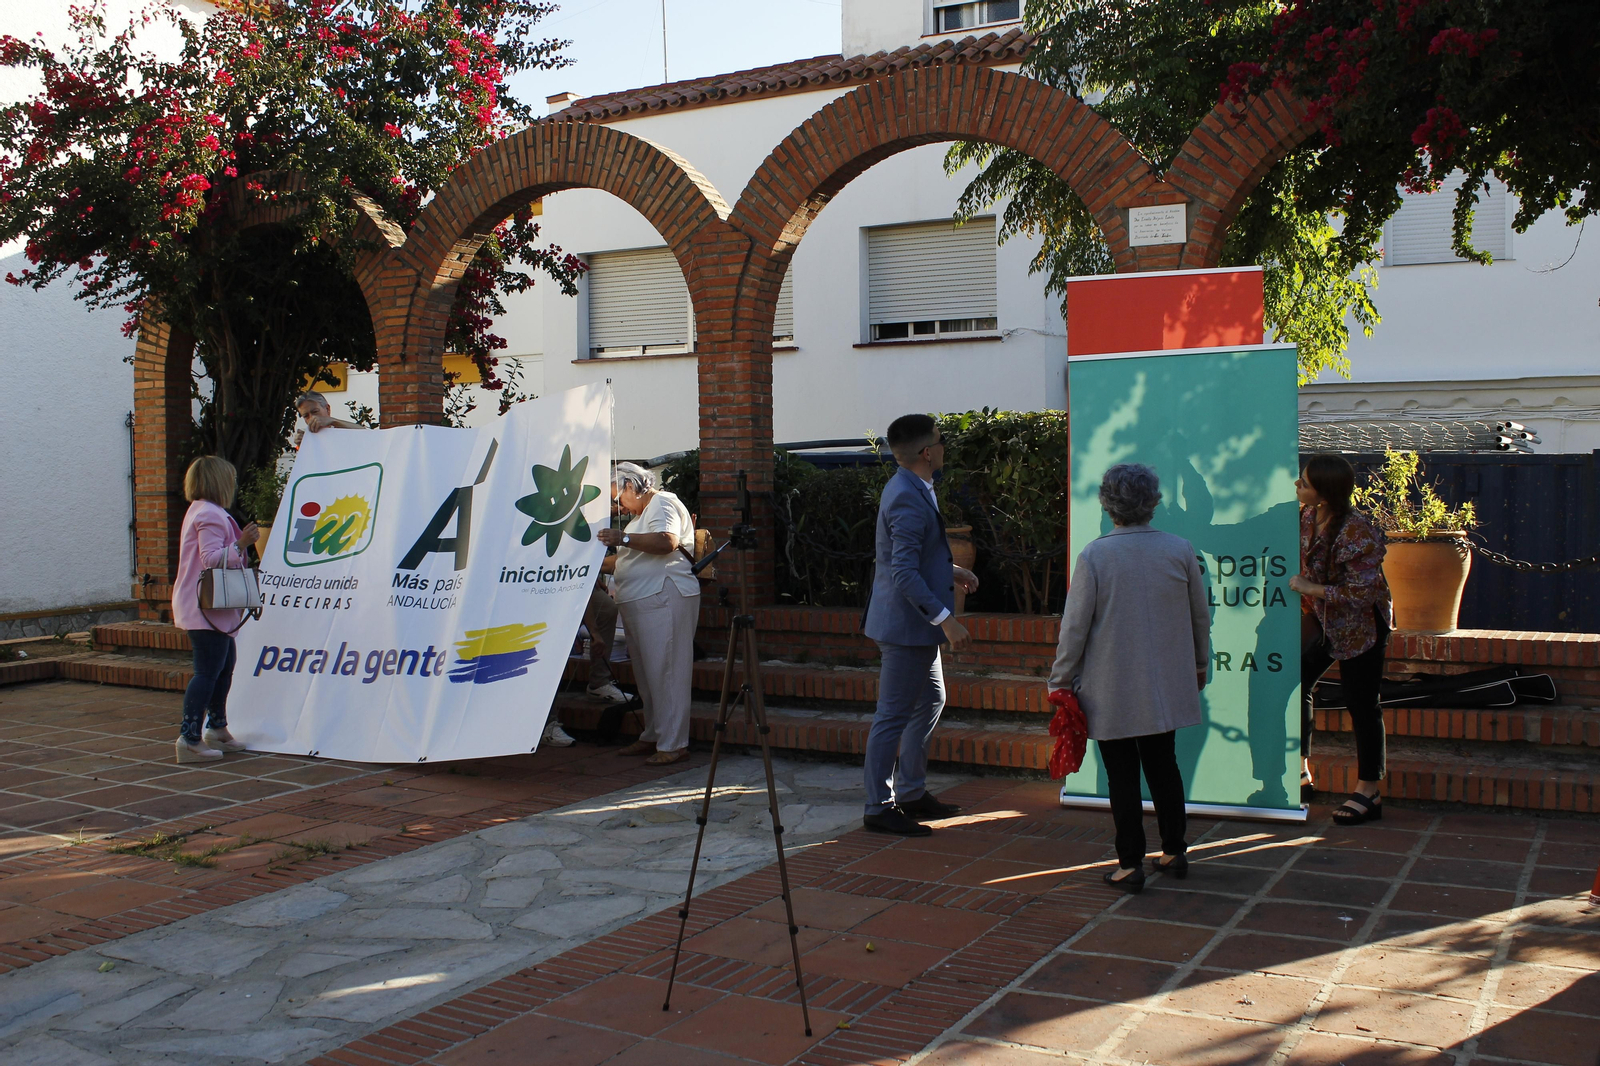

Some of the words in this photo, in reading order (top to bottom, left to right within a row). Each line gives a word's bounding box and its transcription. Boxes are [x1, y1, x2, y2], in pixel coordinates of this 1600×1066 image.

[499, 564, 590, 583] iniciativa
[1217, 547, 1287, 584] país
[261, 571, 322, 589] izquierda
[323, 576, 359, 590] unida
[391, 573, 429, 591] Más
[432, 574, 463, 594] país
[530, 587, 557, 595] Pueblo
[557, 583, 585, 593] Andaluz
[260, 592, 353, 610] ALGECIRAS
[386, 594, 457, 610] ANDALUCÍA
[1207, 580, 1287, 607] LUCÍA
[253, 644, 328, 677] para
[331, 641, 359, 676] la
[361, 645, 447, 684] gente
